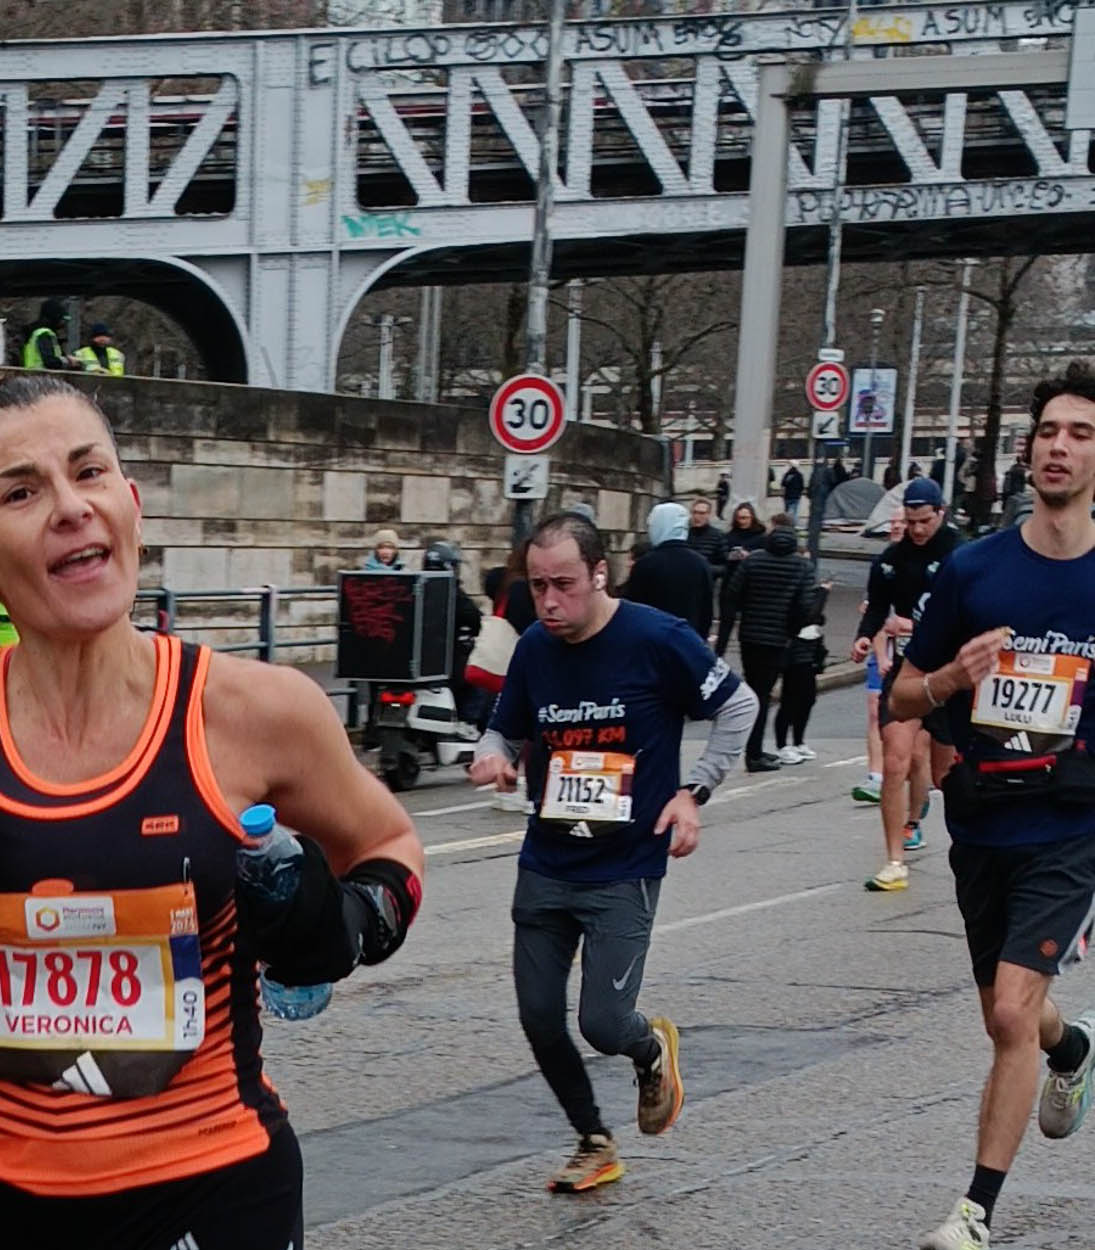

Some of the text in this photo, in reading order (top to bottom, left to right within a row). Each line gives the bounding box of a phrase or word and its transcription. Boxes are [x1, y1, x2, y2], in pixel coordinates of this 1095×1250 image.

[816, 376, 840, 396] 30
[506, 398, 549, 430] 30
[991, 678, 1057, 713] 19277
[4, 1014, 133, 1035] VERONICA
